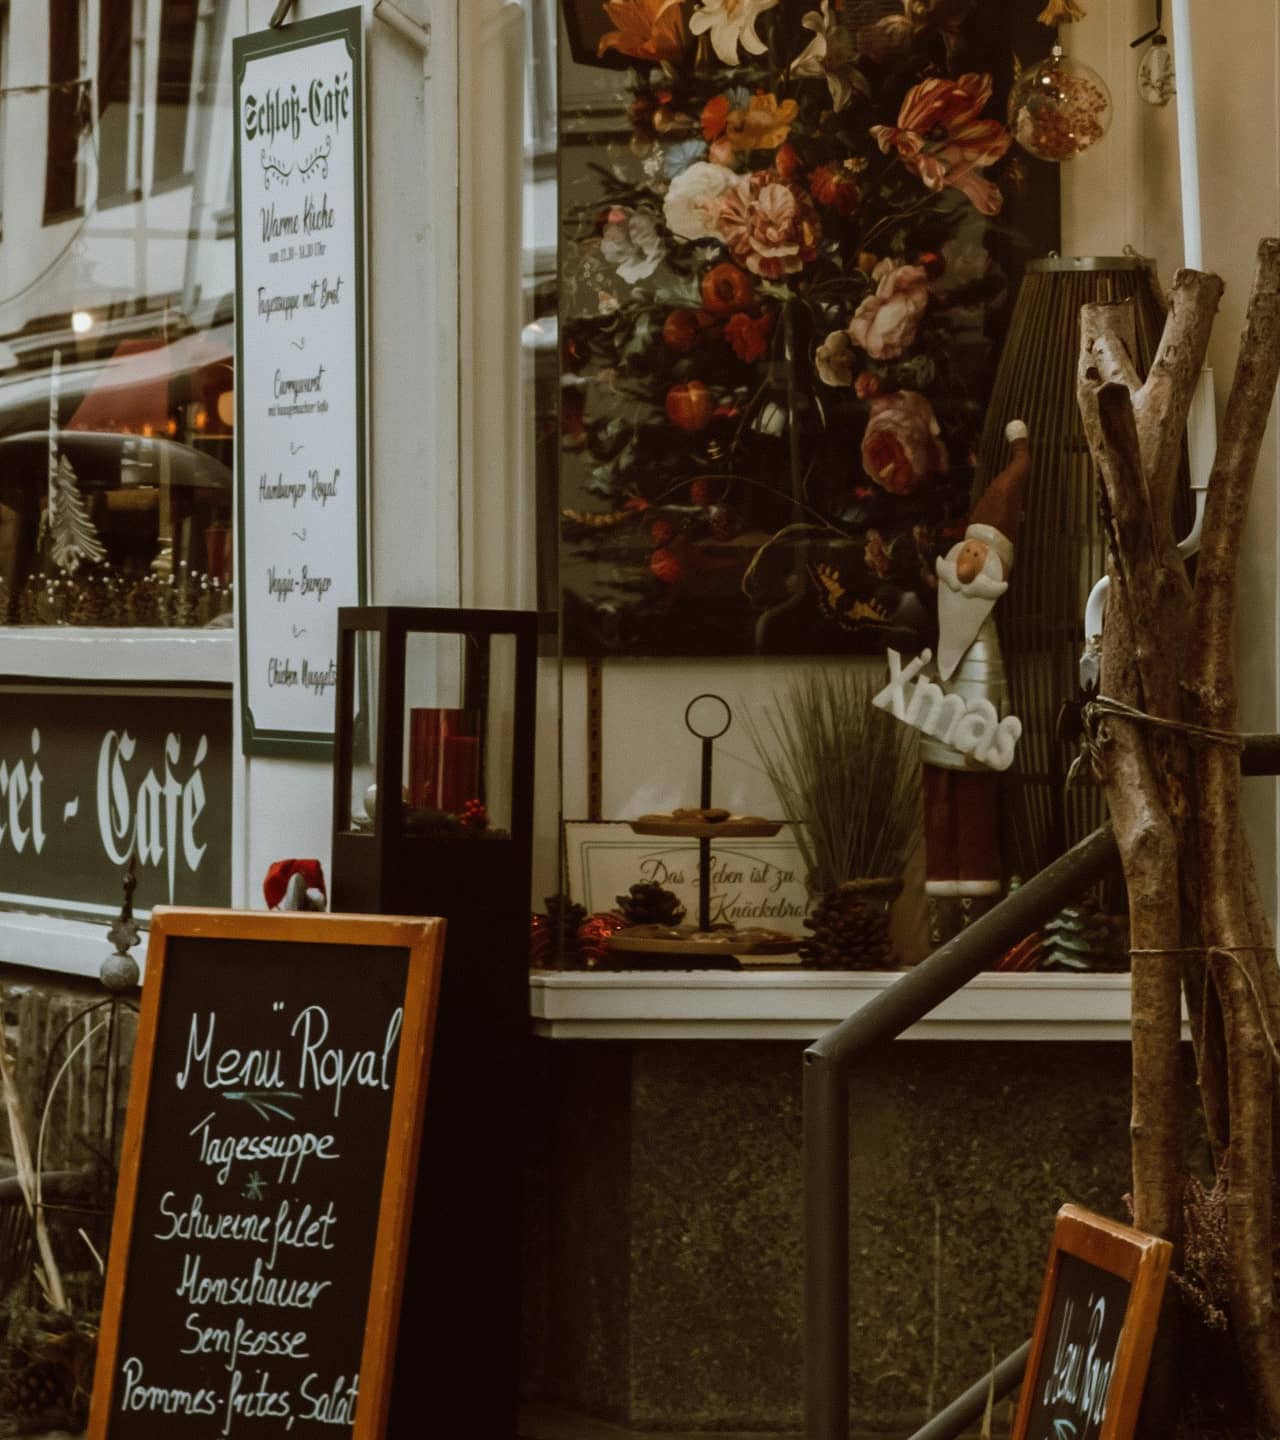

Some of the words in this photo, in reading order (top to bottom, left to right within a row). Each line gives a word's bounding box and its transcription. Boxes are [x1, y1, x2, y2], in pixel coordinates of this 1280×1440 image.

[96, 729, 209, 906] Café
[639, 858, 684, 886] Das
[750, 863, 769, 884] ist
[773, 865, 796, 893] zu
[290, 1004, 406, 1116] Royal
[189, 1111, 341, 1185] Tagessuppe
[154, 1191, 338, 1271] Schweinefilet
[175, 1254, 333, 1311] Monschauer
[180, 1313, 311, 1372] Senfsosse
[299, 1372, 362, 1428] Salat
